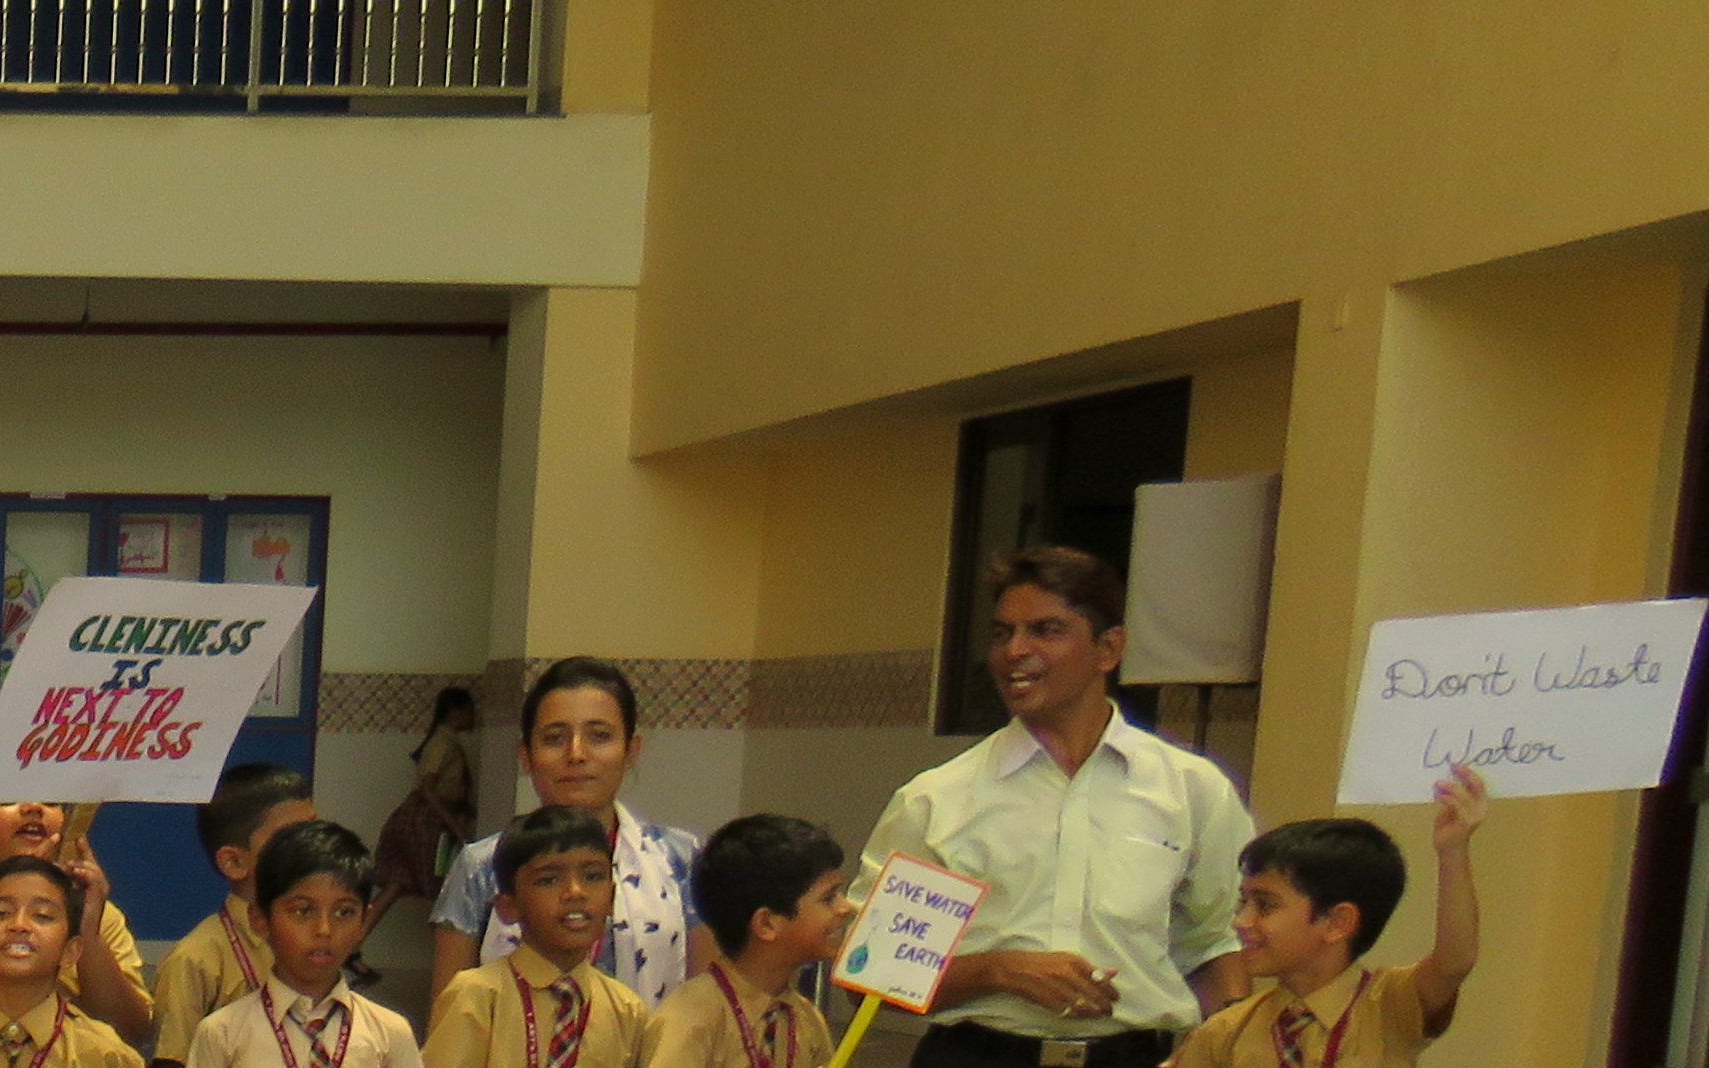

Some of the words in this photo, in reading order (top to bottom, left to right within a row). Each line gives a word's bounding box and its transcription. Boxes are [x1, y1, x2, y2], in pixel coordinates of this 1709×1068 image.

[68, 614, 267, 656] CLENINESS
[98, 658, 165, 691] IS
[1380, 652, 1515, 700] Don't
[1533, 643, 1661, 693] Waste
[31, 686, 134, 726] NEXT
[134, 685, 185, 726] TO
[15, 720, 204, 770] GODINESS
[883, 874, 925, 904] SAVE
[888, 912, 931, 940] SAVE
